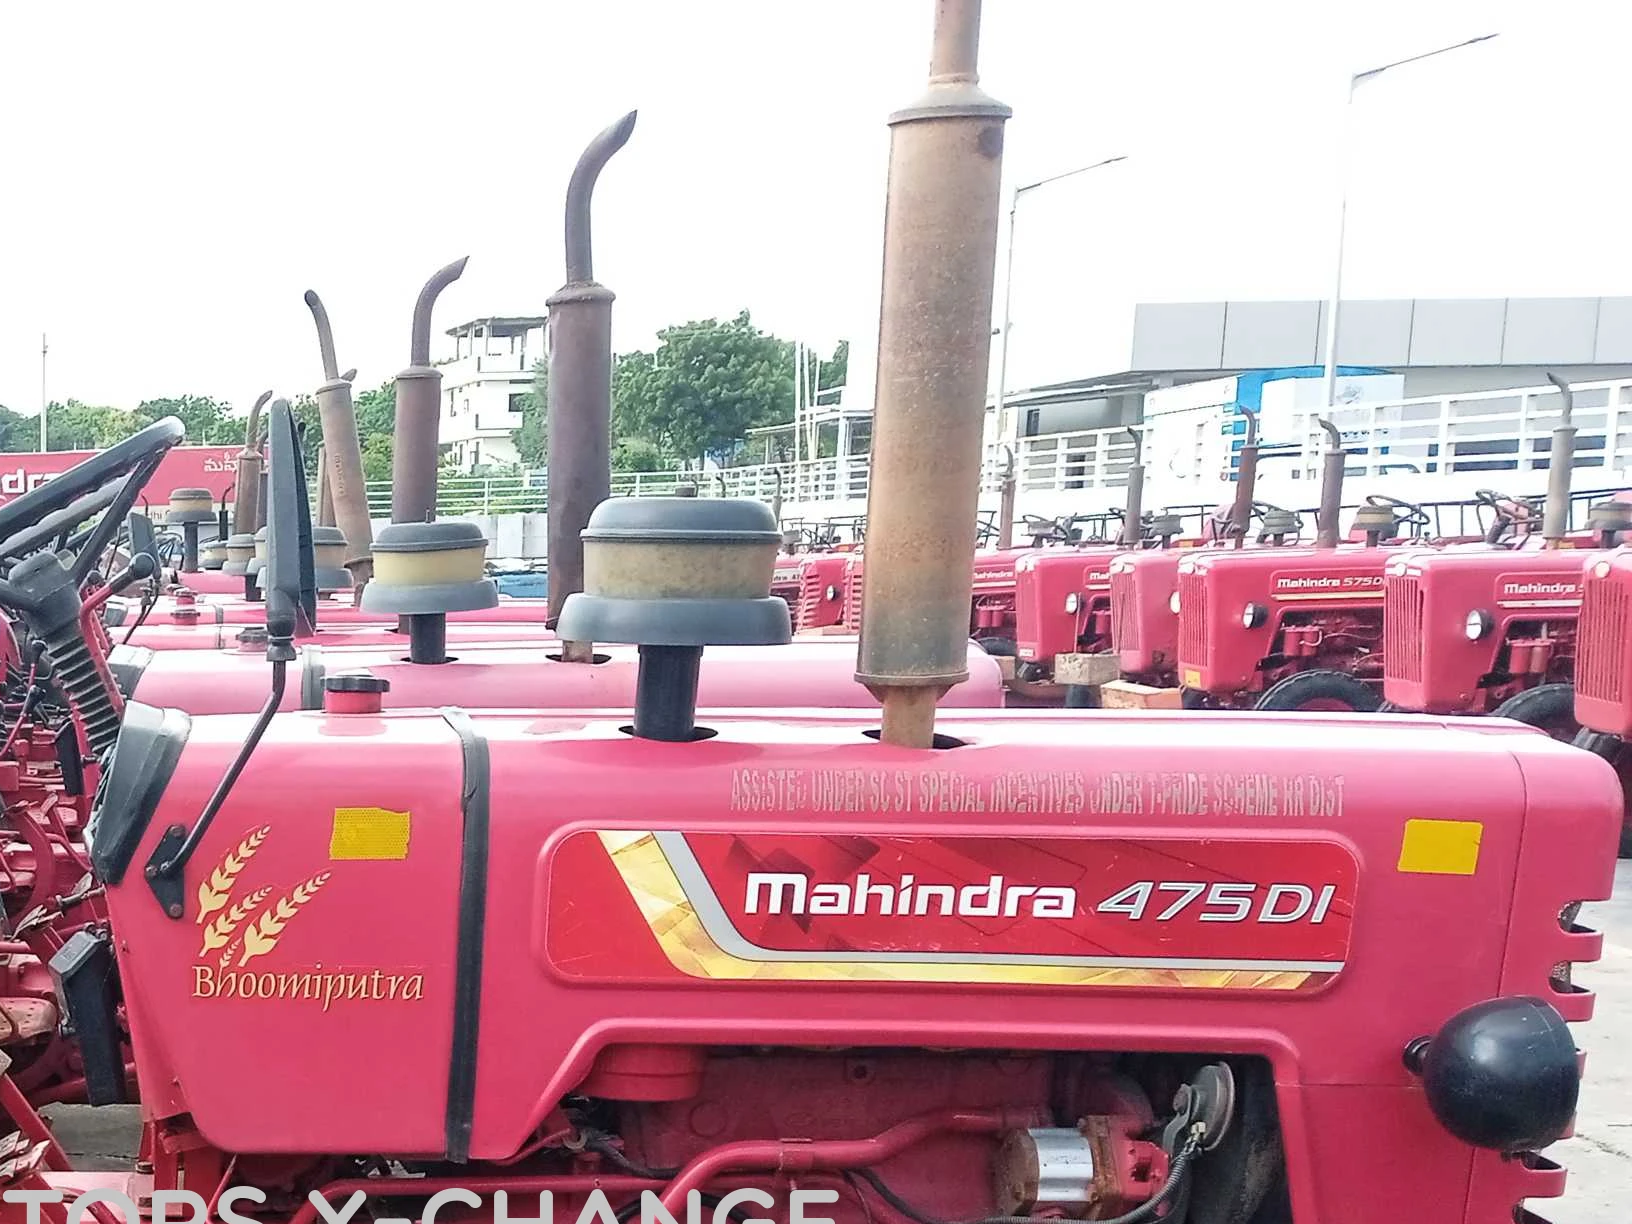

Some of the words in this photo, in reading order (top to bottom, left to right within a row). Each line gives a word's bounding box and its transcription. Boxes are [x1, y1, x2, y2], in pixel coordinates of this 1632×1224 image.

[1277, 577, 1341, 589] Mahindra
[1504, 582, 1576, 594] Mahindra
[810, 769, 865, 812] UNDER
[869, 770, 890, 812] SC
[894, 770, 913, 812] ST
[918, 770, 985, 813] SPECIAL
[989, 771, 1085, 814] INCENTIVES
[1089, 772, 1143, 814] UNDER
[744, 872, 1077, 919] Mahindra
[191, 961, 425, 1012] Bhoomiputra
